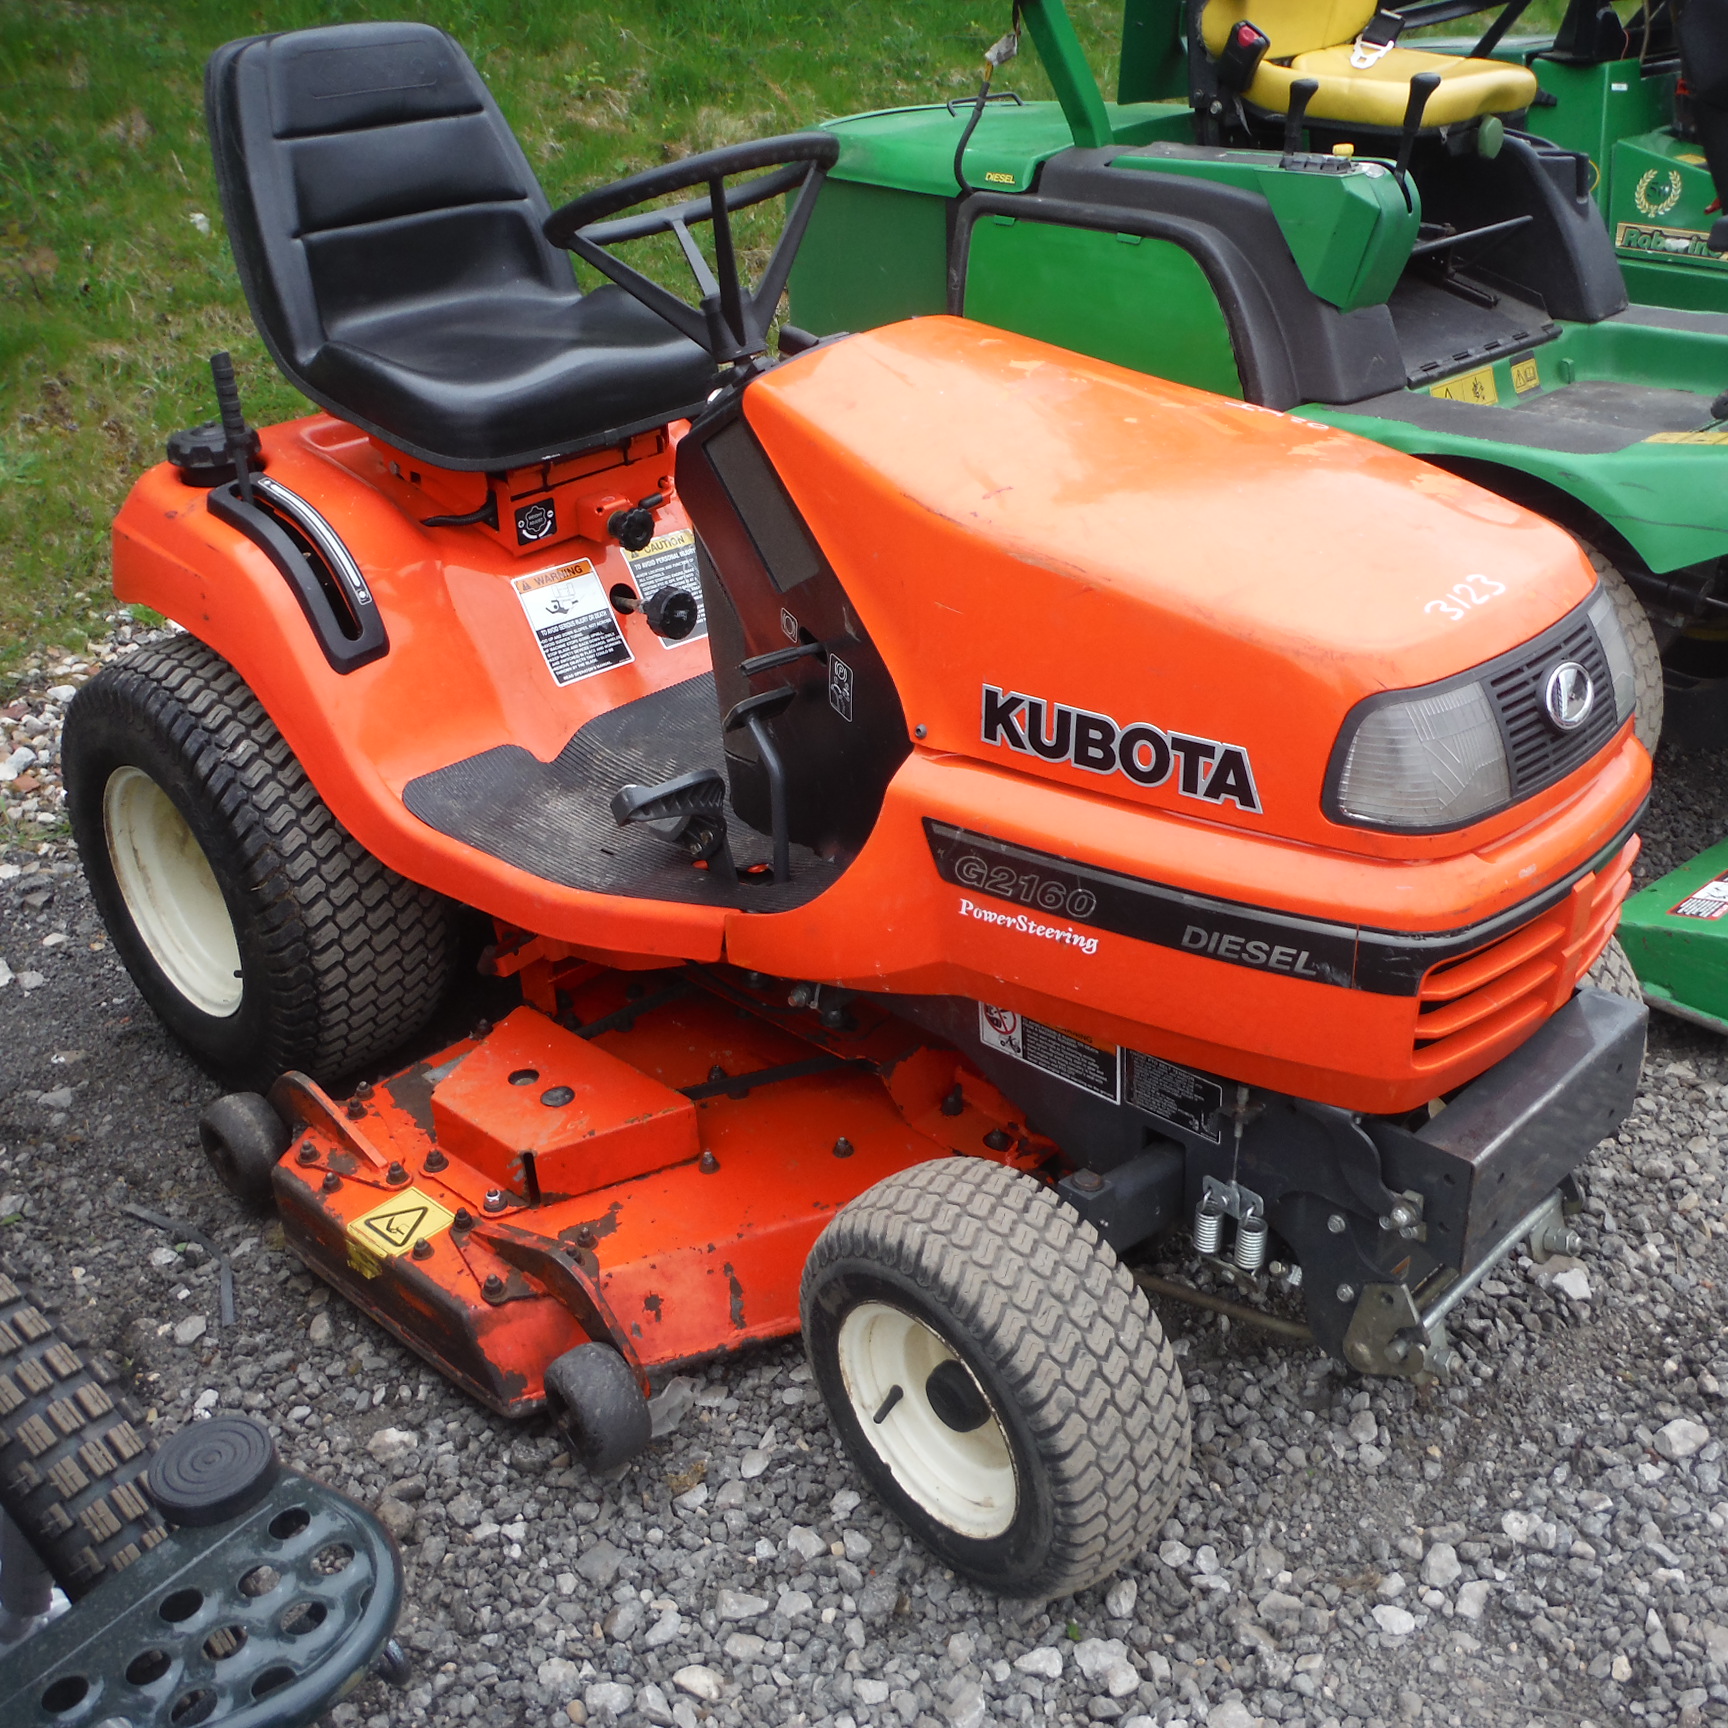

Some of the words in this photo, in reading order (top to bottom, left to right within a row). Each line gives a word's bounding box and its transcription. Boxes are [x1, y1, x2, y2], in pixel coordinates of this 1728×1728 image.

[984, 172, 1016, 184] DIESEL
[644, 535, 686, 555] CAUTION
[534, 565, 583, 586] WARNING
[981, 683, 1263, 814] KUBOTA
[955, 856, 1097, 918] G2160
[958, 898, 1099, 955] PowerSteering
[1181, 925, 1317, 976] DIESEL
